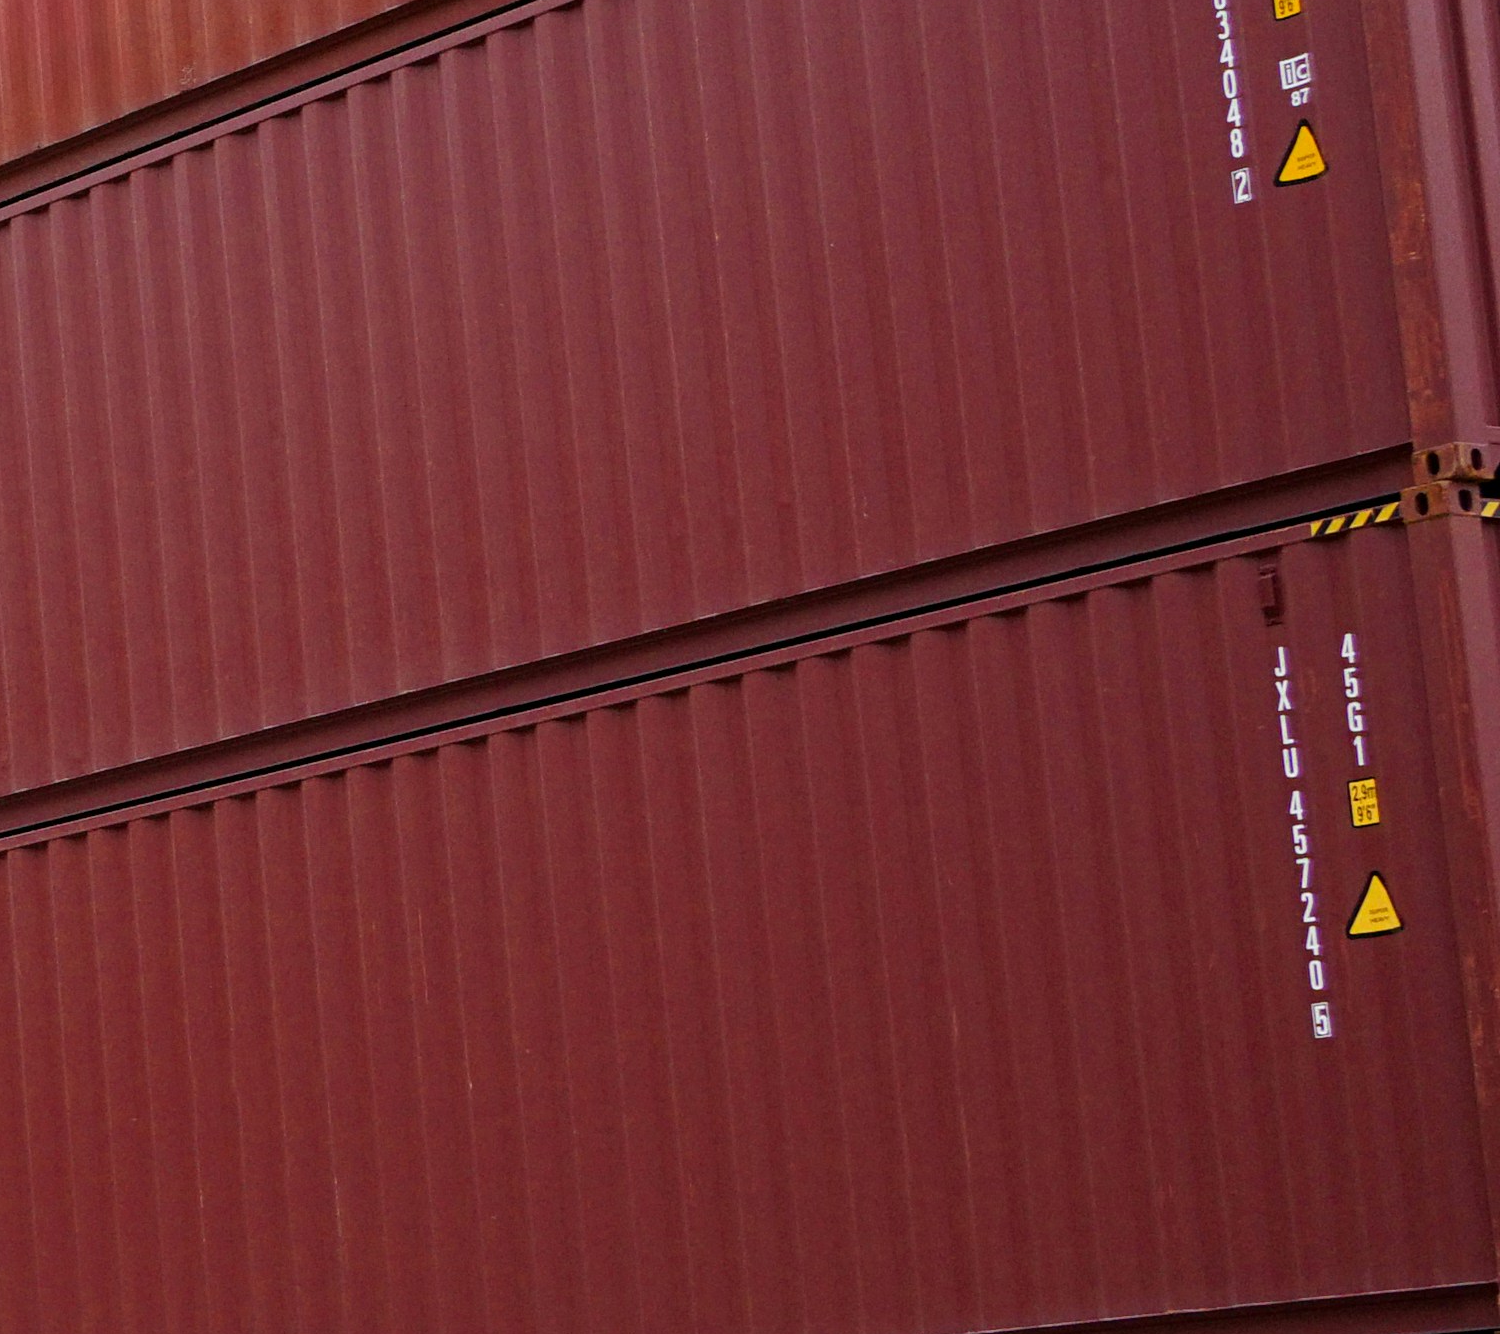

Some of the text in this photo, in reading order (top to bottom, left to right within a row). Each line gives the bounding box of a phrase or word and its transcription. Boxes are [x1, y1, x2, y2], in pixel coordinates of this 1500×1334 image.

[1291, 88, 1310, 107] 87
[1340, 632, 1365, 767] 45G1
[1273, 646, 1299, 780] JXLU
[1288, 790, 1325, 991] 457240
